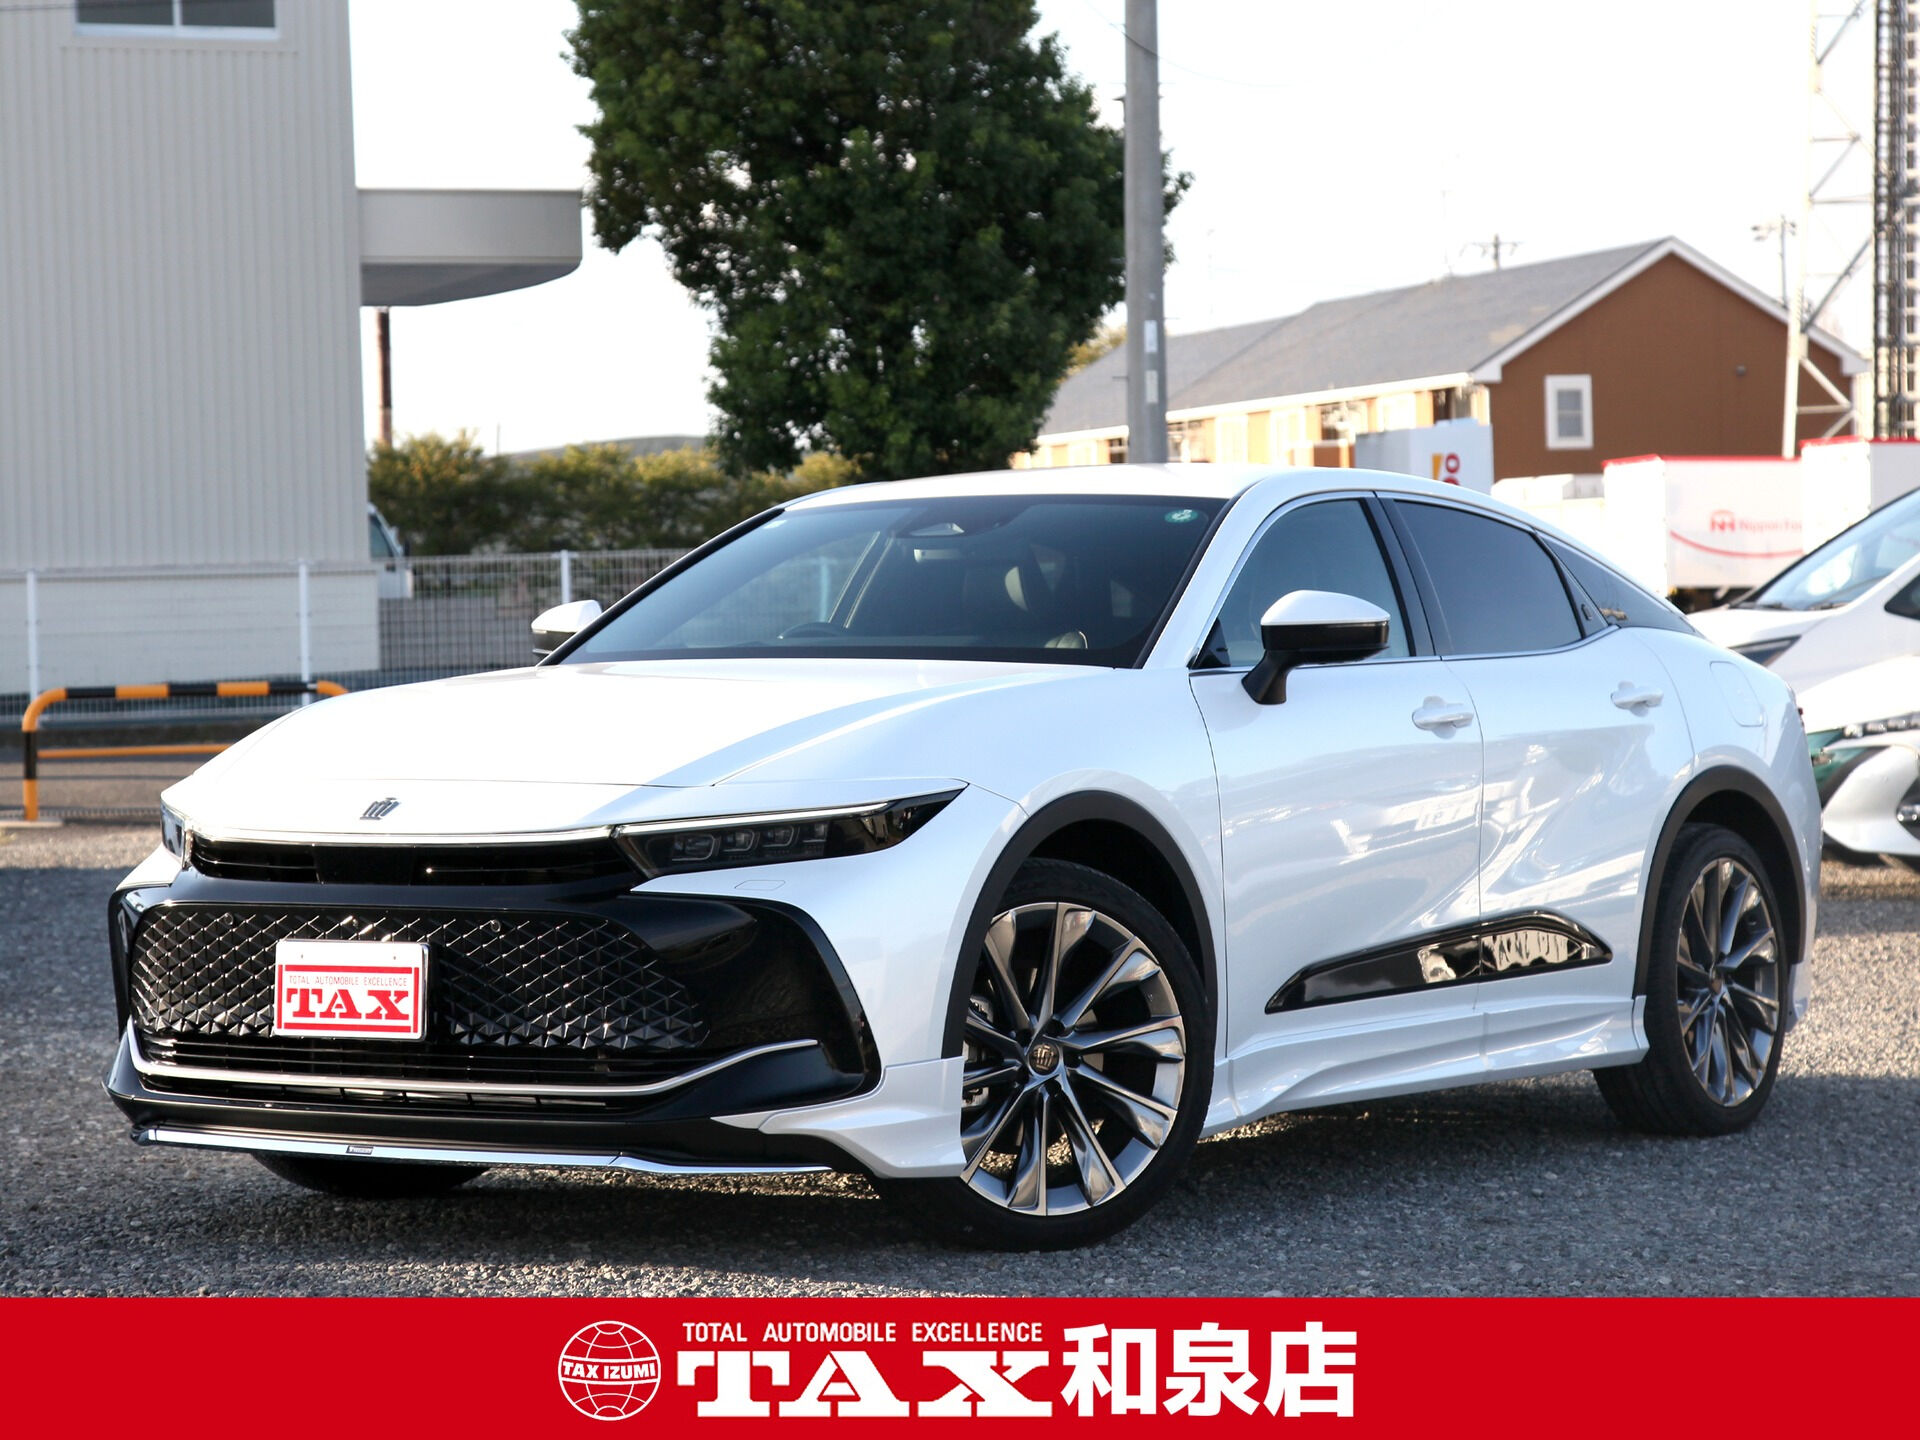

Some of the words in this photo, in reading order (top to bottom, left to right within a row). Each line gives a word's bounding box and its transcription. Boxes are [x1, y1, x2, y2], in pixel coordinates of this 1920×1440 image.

[289, 975, 311, 985] TOTAL
[315, 976, 359, 986] AUTOMOBILE
[363, 977, 407, 987] EXCELLENCE
[286, 988, 410, 1020] TAX
